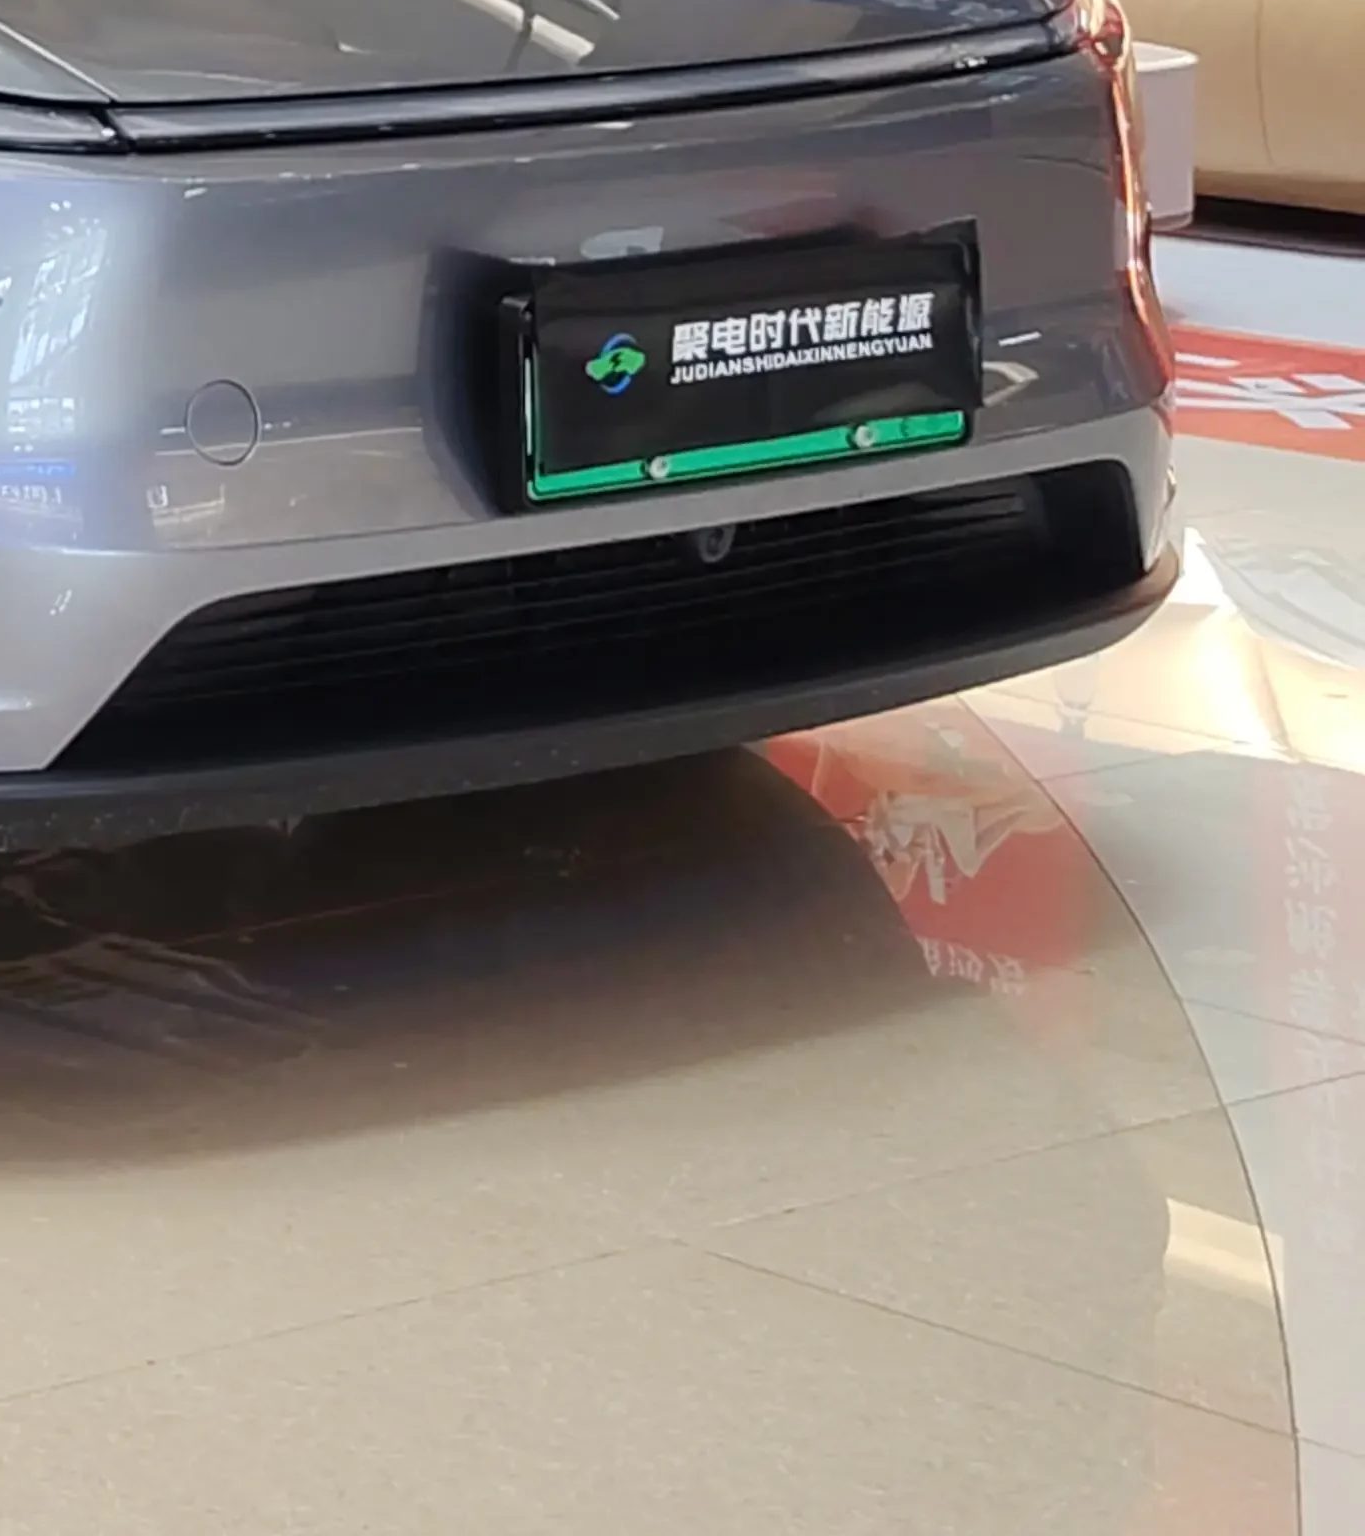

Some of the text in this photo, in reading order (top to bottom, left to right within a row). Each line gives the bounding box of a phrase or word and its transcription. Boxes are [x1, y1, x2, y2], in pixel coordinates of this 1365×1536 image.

[670, 292, 935, 363] 聚电时代新能源
